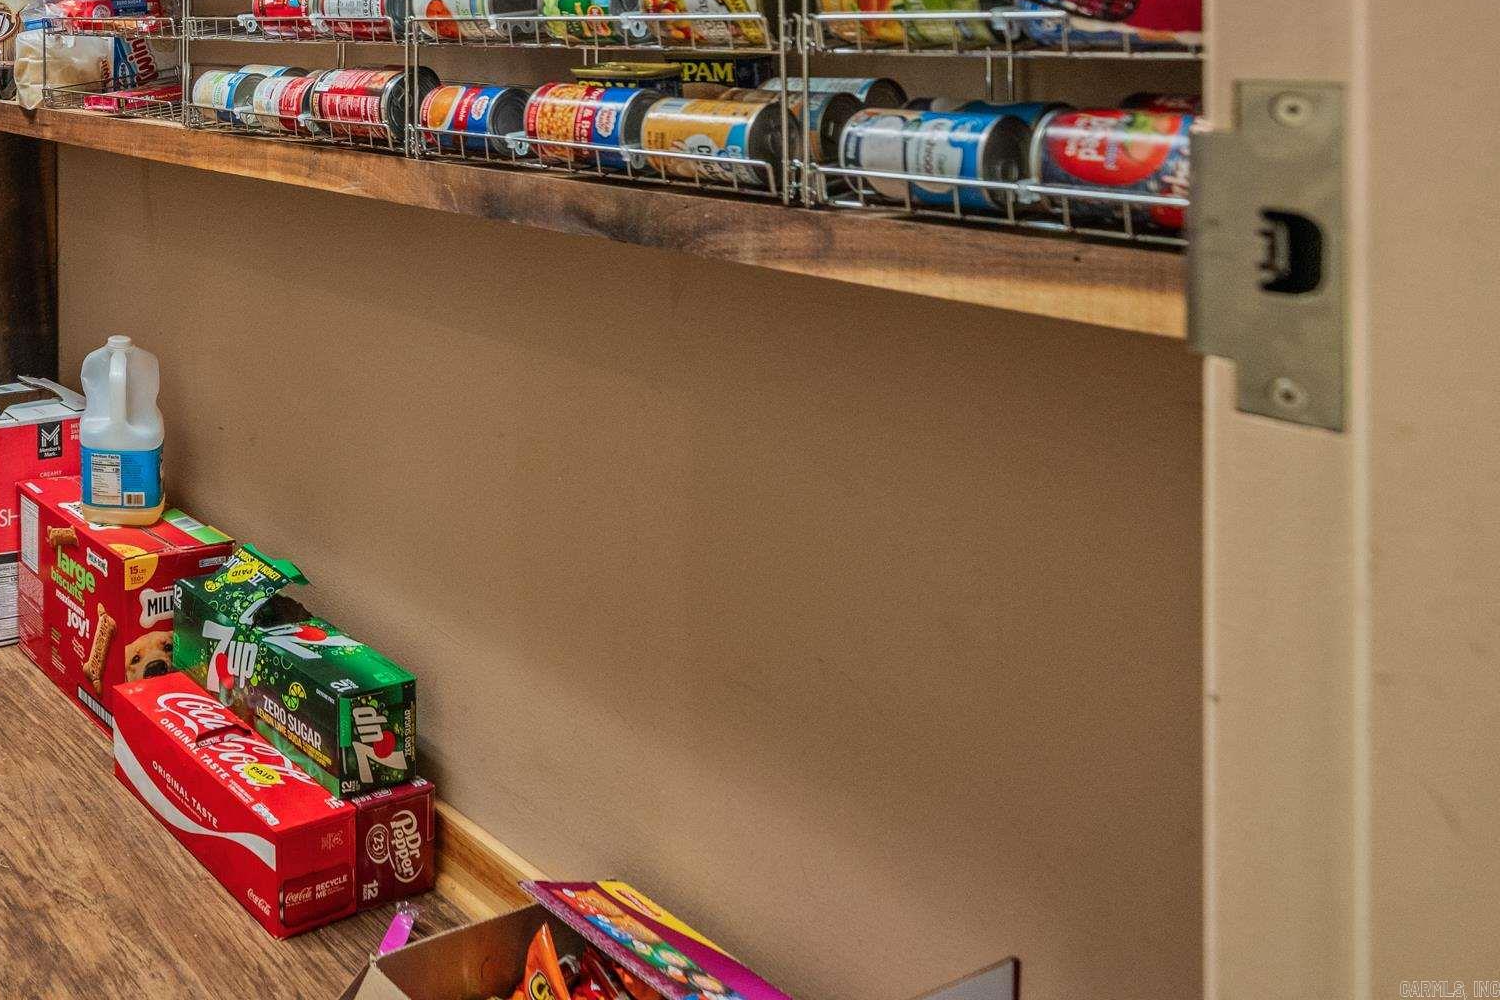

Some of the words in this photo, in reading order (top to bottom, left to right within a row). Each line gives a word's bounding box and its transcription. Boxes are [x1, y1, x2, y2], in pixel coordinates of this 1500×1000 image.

[681, 62, 736, 83] PAM
[56, 545, 97, 594] large
[129, 565, 139, 575] 15
[55, 588, 86, 618] maximum
[66, 611, 91, 639] joy!
[262, 695, 289, 726] ZERO
[286, 713, 323, 751] SUGAR
[403, 708, 412, 736] SUGAR
[160, 717, 201, 755] ORIGINAL
[199, 753, 231, 781] TASTE
[403, 735, 413, 758] ZERO
[250, 765, 275, 781] PAID
[152, 760, 190, 802] ORIGINAL
[191, 796, 219, 829] TASTE
[372, 834, 385, 851] 23
[315, 874, 349, 892] RECYCLE
[367, 880, 379, 898] 12
